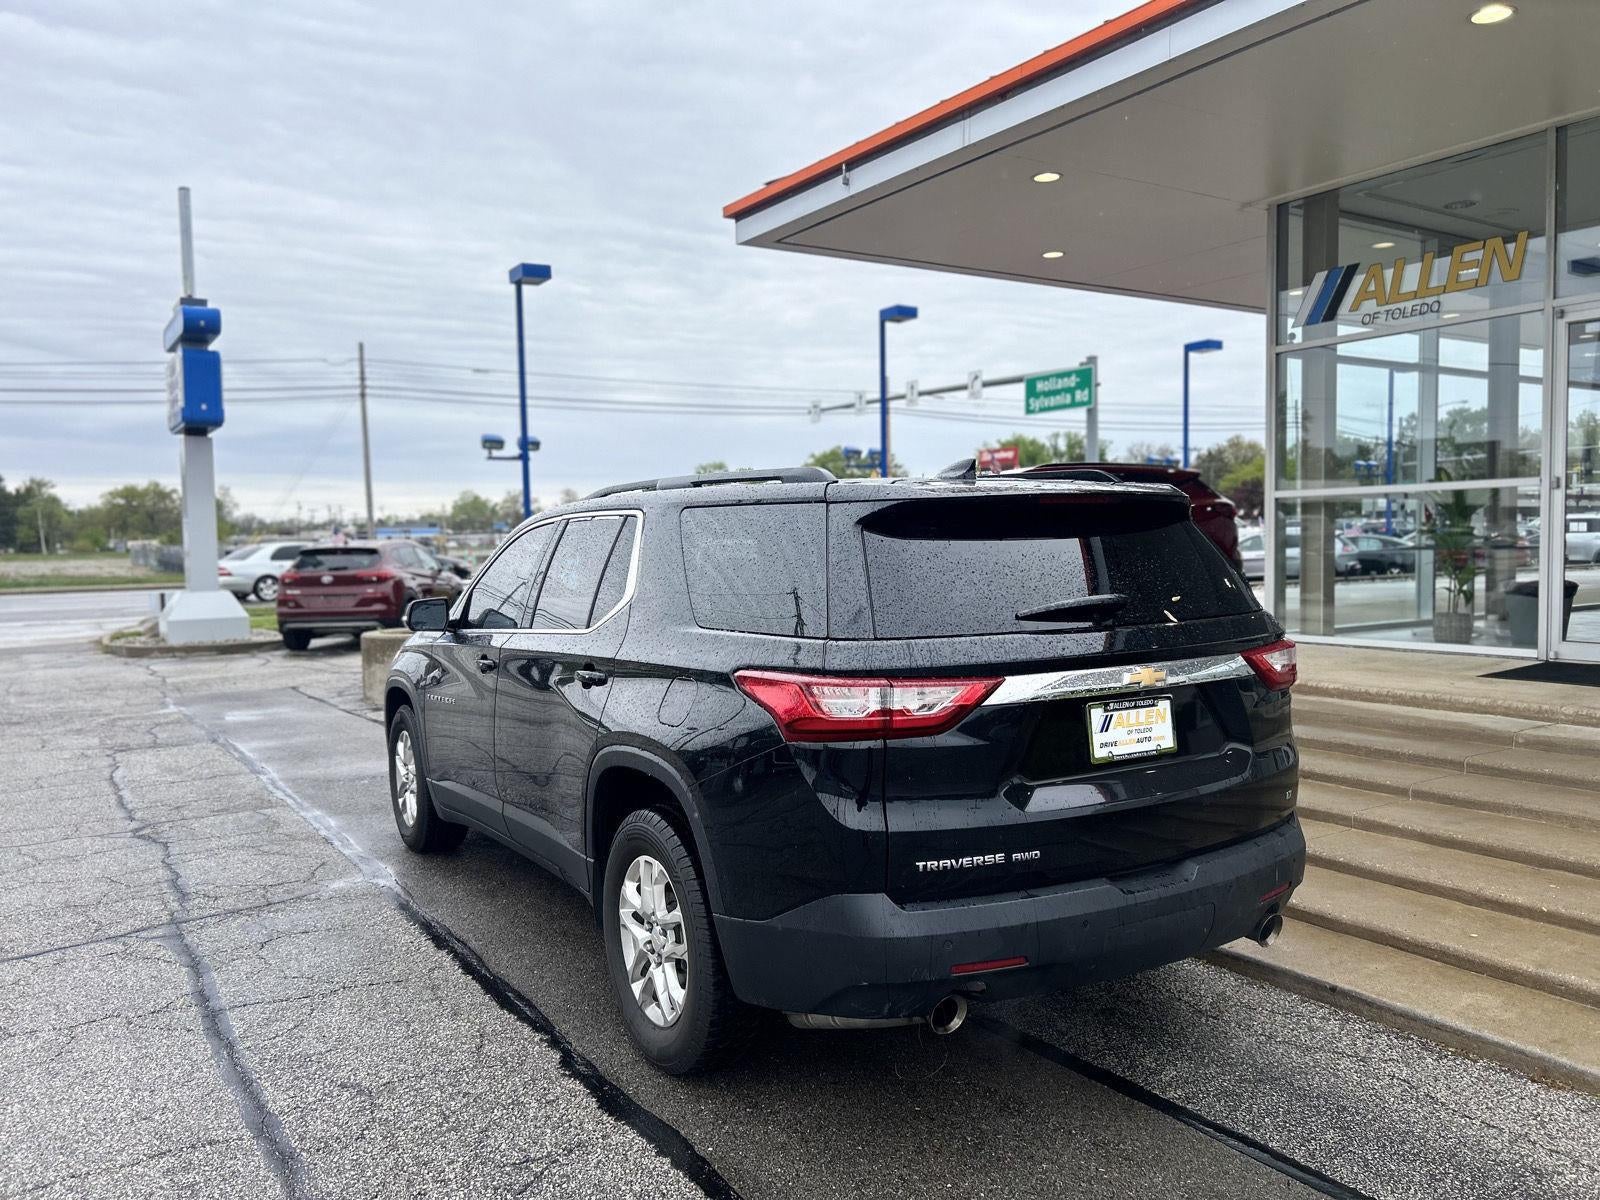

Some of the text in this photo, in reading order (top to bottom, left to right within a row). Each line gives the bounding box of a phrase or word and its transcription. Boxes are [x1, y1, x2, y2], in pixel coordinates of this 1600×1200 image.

[1348, 230, 1529, 313] ALLEN
[1361, 300, 1442, 326] OF TOLEDO
[1035, 373, 1081, 393] Holland-
[1028, 388, 1089, 413] Sylvania Rd
[1136, 699, 1154, 707] TOLEDO
[1113, 708, 1167, 729] ALLEN
[1134, 727, 1152, 735] TOLEDO
[915, 850, 1041, 872] TRAVERSE AWD
